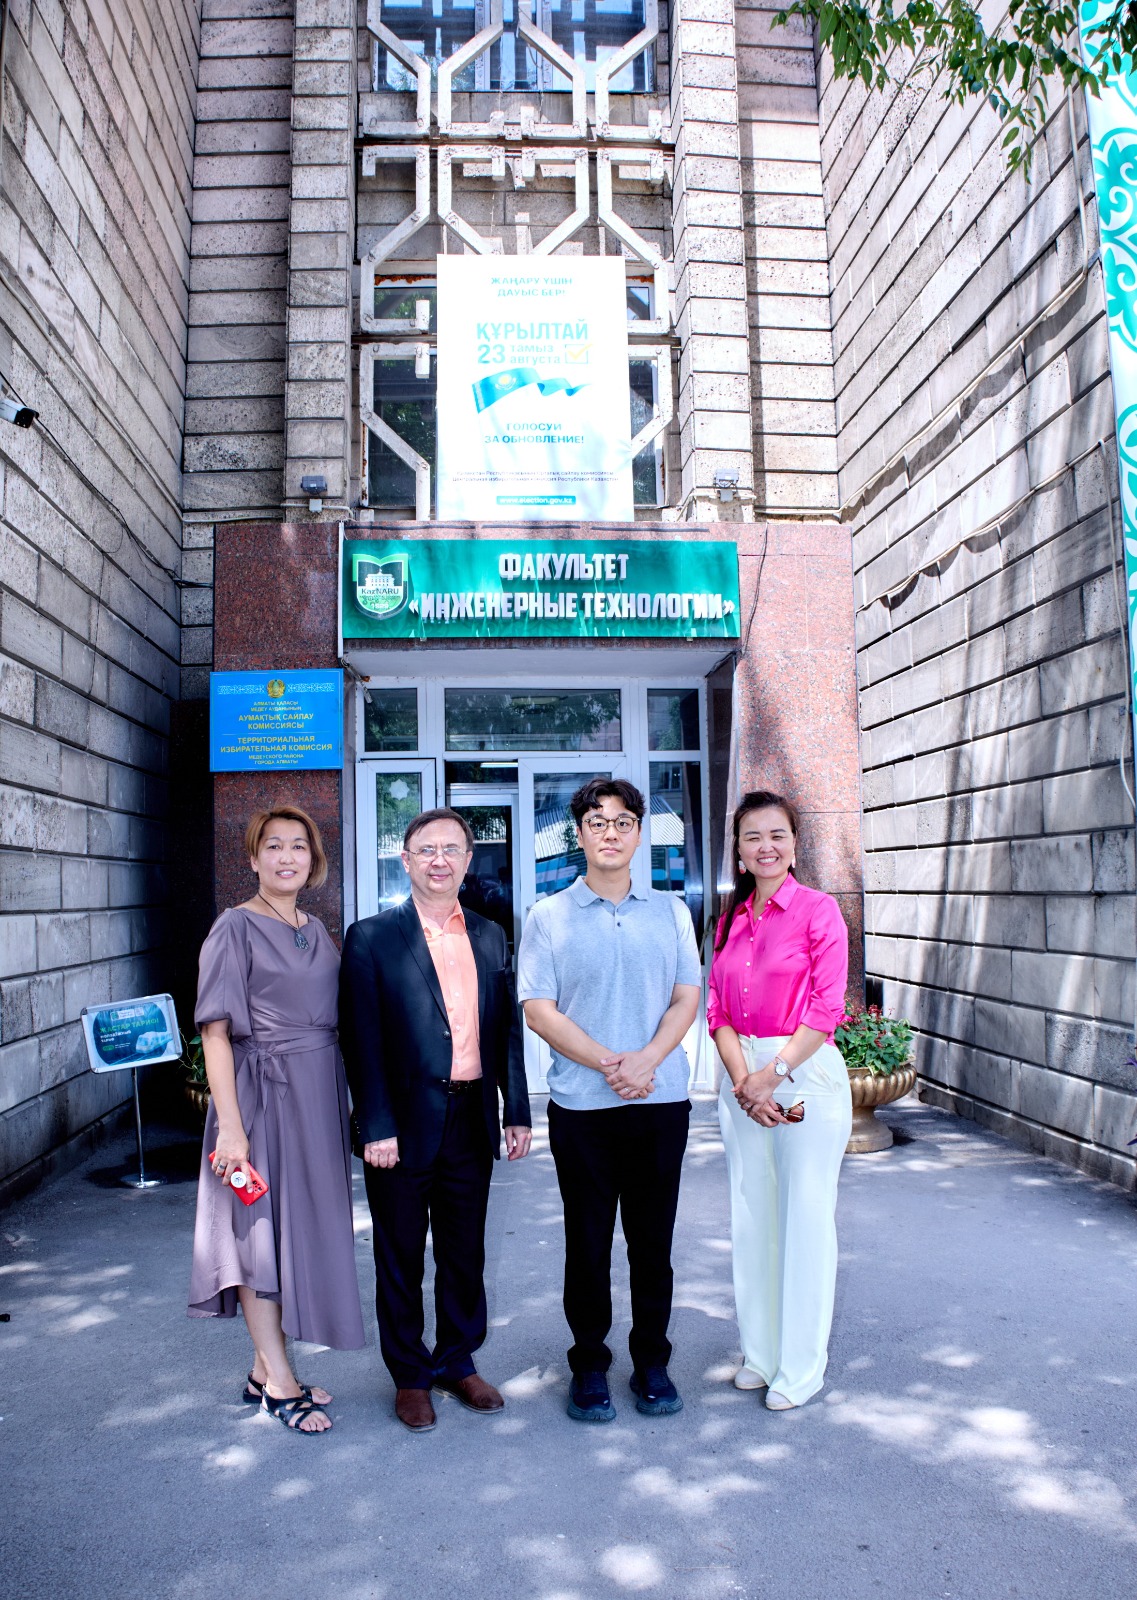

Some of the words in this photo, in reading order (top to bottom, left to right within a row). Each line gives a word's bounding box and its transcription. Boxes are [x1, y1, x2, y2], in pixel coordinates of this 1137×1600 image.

[491, 277, 540, 286] ЖАҢАРУ
[497, 289, 539, 297] ДАУЫС
[476, 318, 588, 342] ҚҰРЫЛТАЙ
[477, 343, 506, 364] 23
[510, 344, 554, 353] тамыз
[510, 355, 561, 366] августа
[484, 435, 499, 444] ЗА
[502, 435, 584, 444] ОБНОВЛЕНИЕ!
[499, 553, 629, 581] ФАКУЛЬТЕТ
[408, 592, 578, 619] «ИНЖЕНЕРНЫЕ
[581, 592, 736, 619] ТЕХНОЛОГИИ»
[238, 714, 281, 722] АУМАҚТЫҚ
[248, 722, 304, 730] КОМИССИЯСЫ
[237, 736, 315, 744] ТЕРРИТОРИАЛЬНАЯ
[220, 745, 287, 753] ИЗБИРАТЕЛЬНАЯ
[288, 743, 333, 751] КОМИССИЯ
